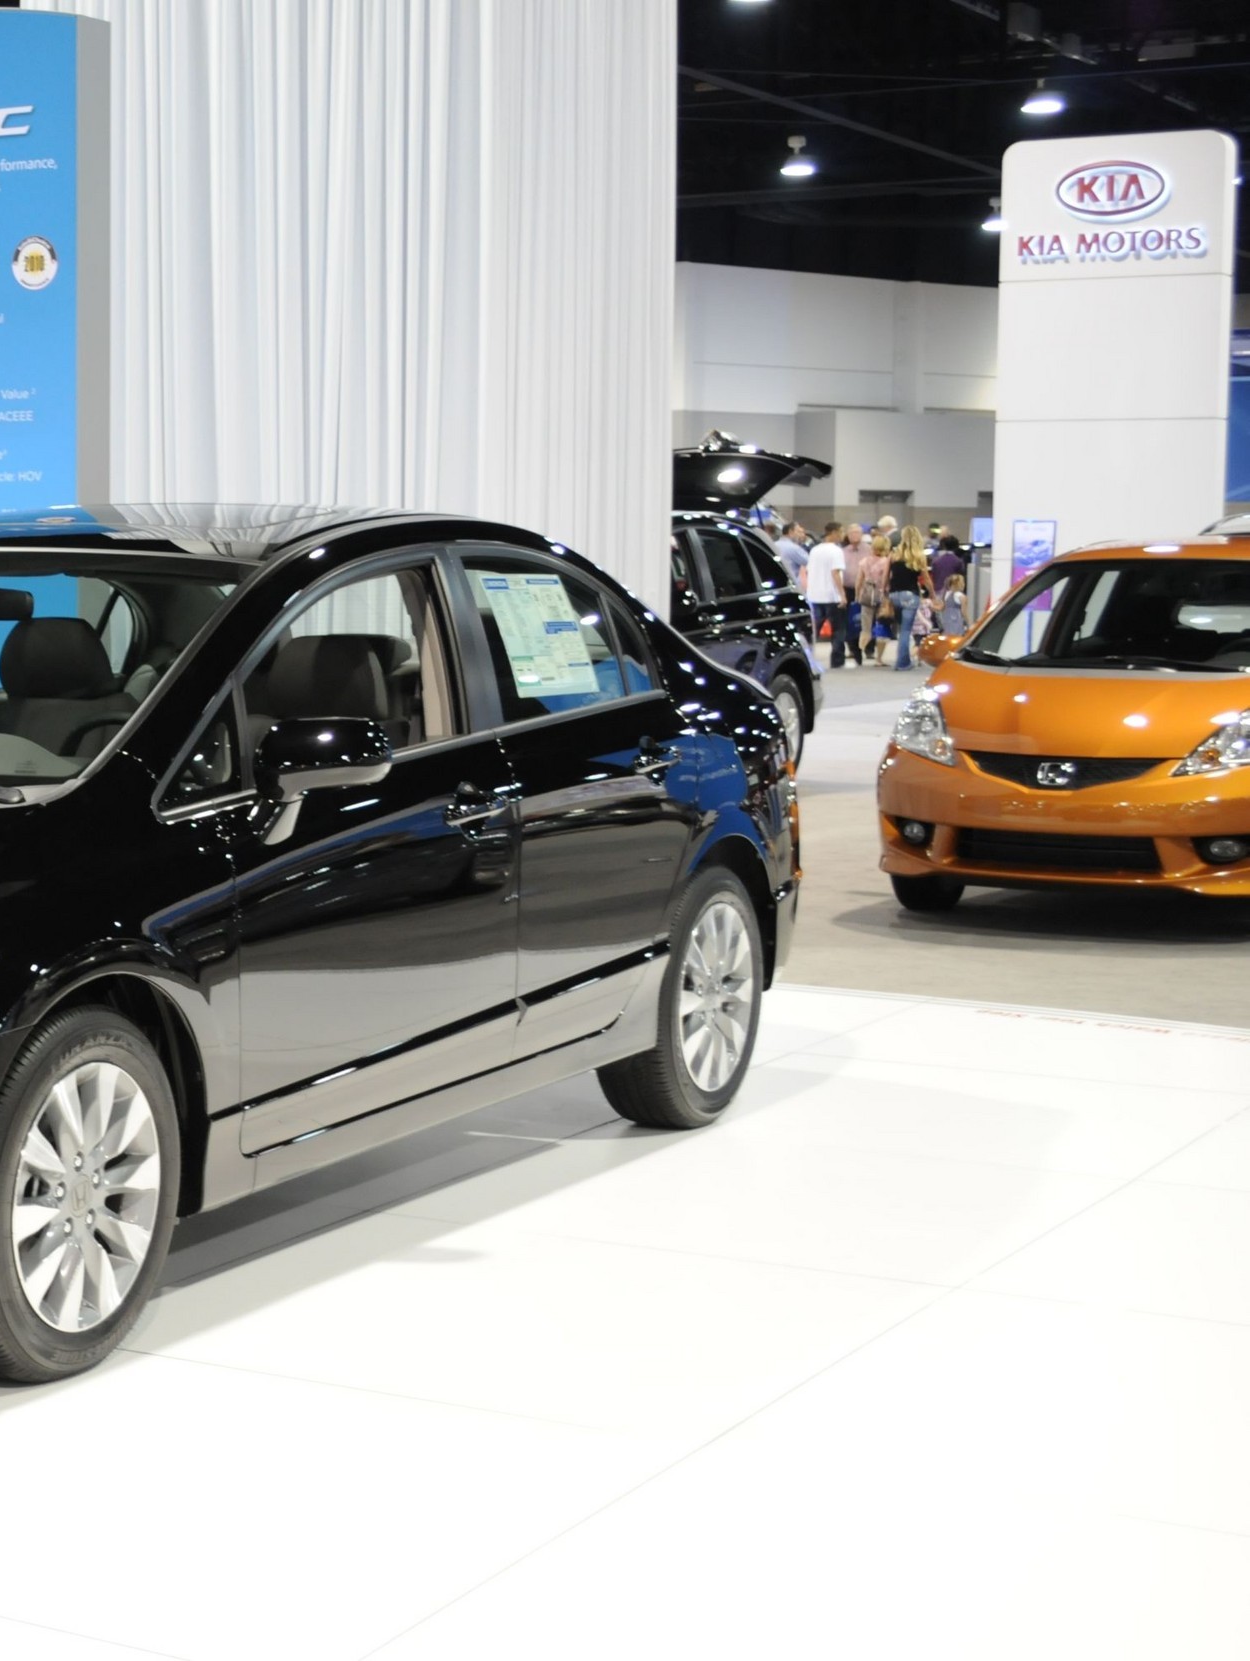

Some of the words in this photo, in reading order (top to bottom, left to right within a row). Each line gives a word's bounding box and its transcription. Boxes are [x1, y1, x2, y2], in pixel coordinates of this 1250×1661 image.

[1076, 173, 1146, 203] KIA
[1017, 234, 1066, 257] KIA
[1076, 227, 1203, 254] MOTORS
[0, 388, 30, 400] Value
[18, 470, 42, 481] HOV
